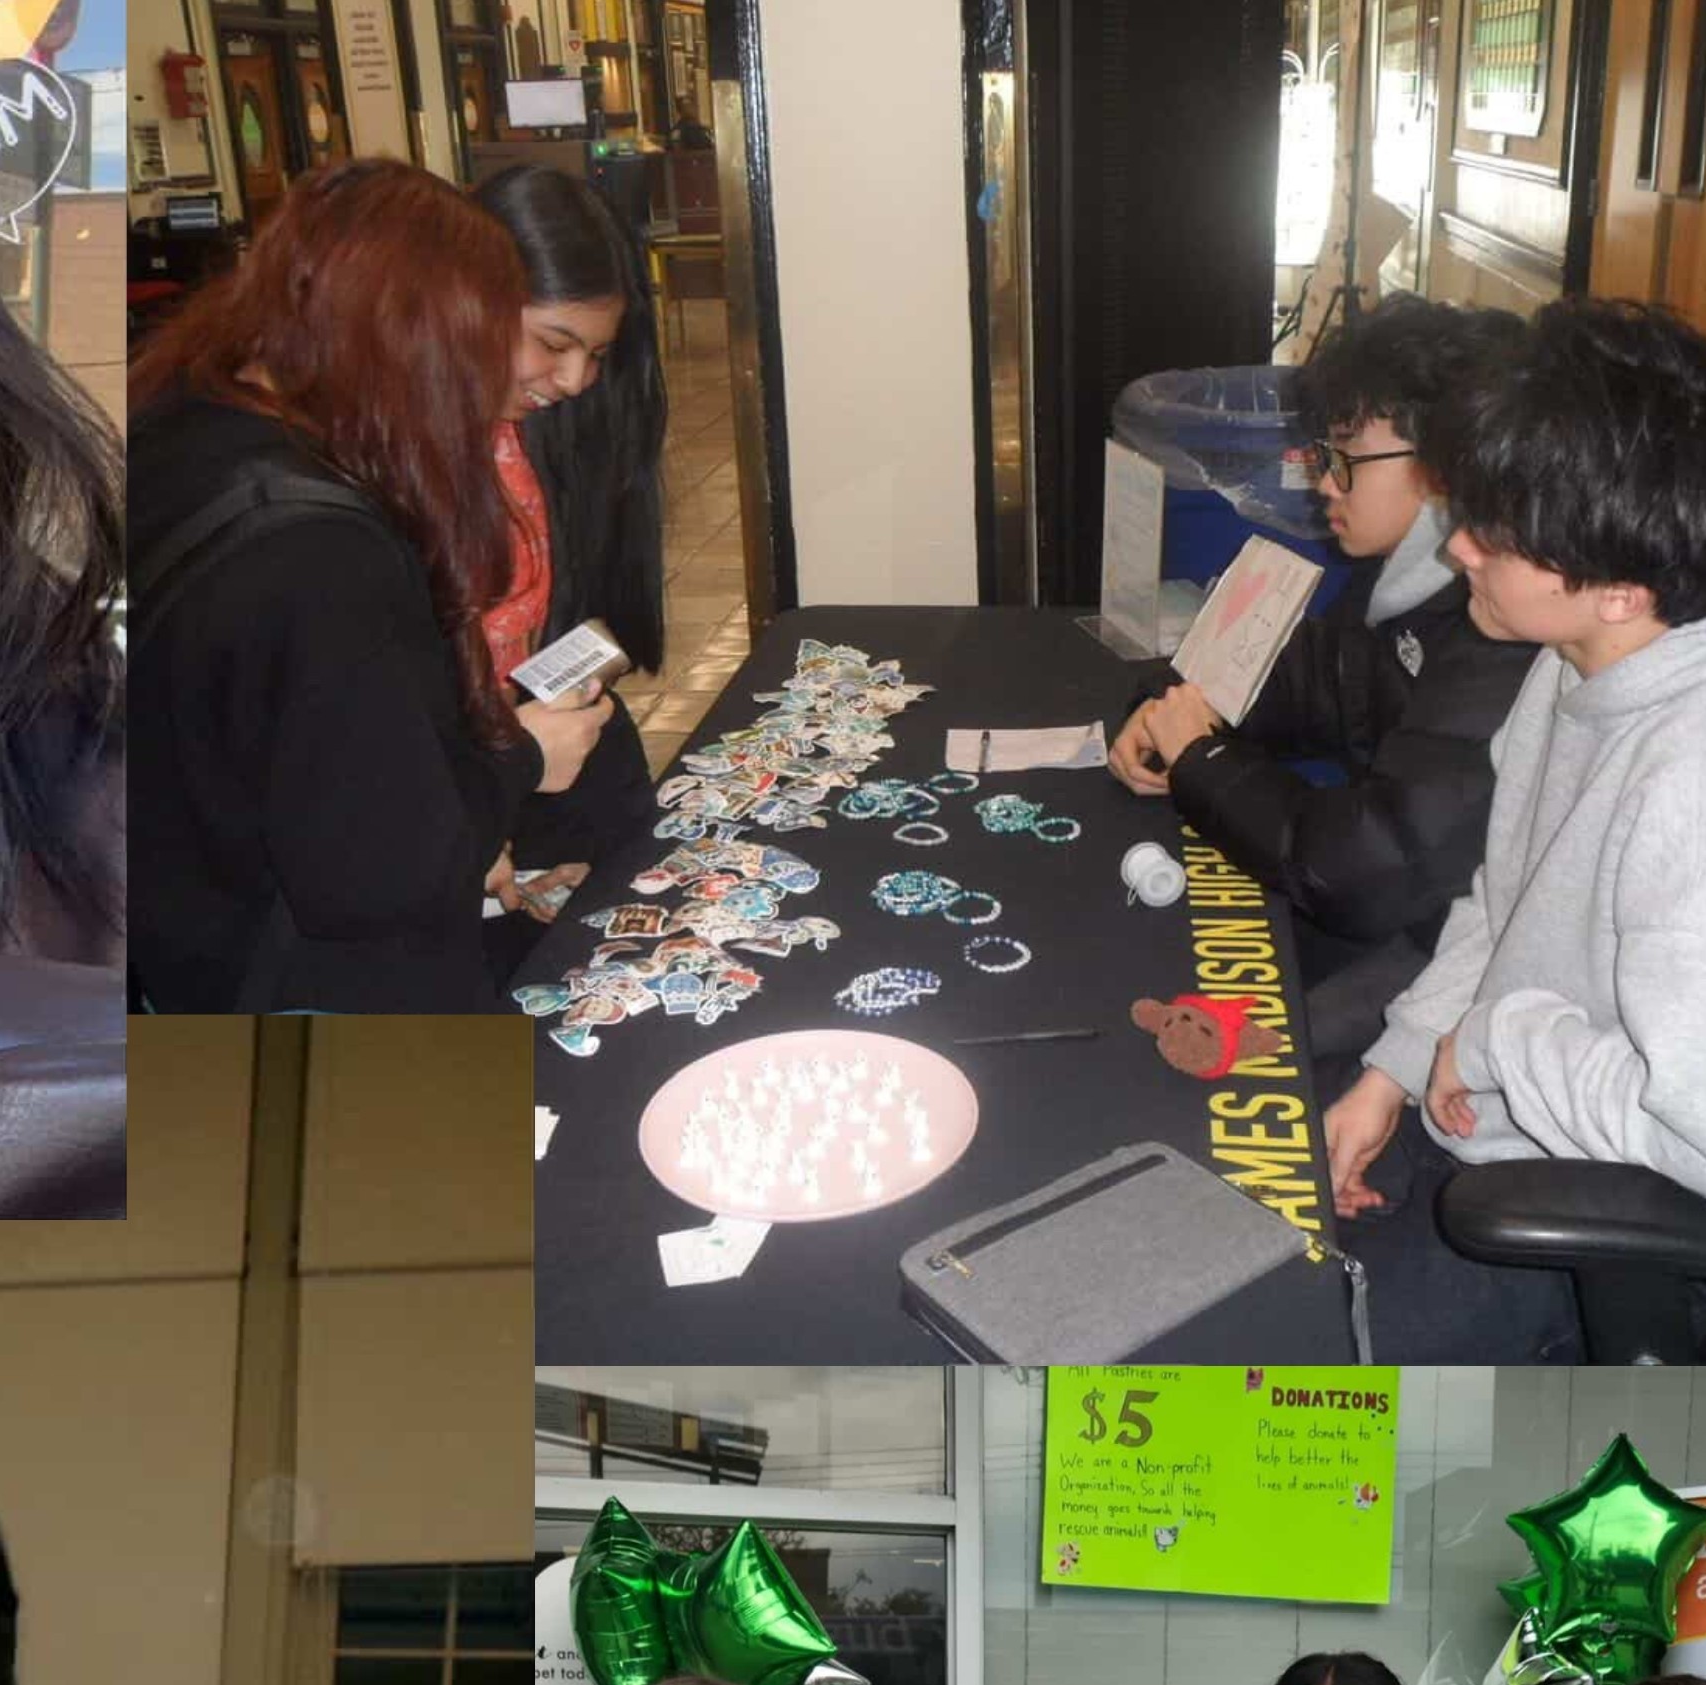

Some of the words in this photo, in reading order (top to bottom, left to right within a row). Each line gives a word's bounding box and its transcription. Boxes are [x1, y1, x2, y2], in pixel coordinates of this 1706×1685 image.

[1271, 1386, 1390, 1415] DONATIONS
[1078, 1387, 1160, 1449] $5
[1256, 1418, 1296, 1440] Please
[1307, 1418, 1349, 1441] donate
[1358, 1420, 1371, 1441] to
[1060, 1453, 1084, 1471] We
[1093, 1457, 1112, 1469] are
[1136, 1454, 1212, 1476] Non-profit
[1255, 1444, 1282, 1467] help
[1288, 1446, 1332, 1466] better
[1340, 1446, 1360, 1466] the
[1182, 1480, 1202, 1497] the
[1061, 1501, 1099, 1518] money
[1107, 1503, 1131, 1517] goes
[1058, 1522, 1100, 1537] rescue
